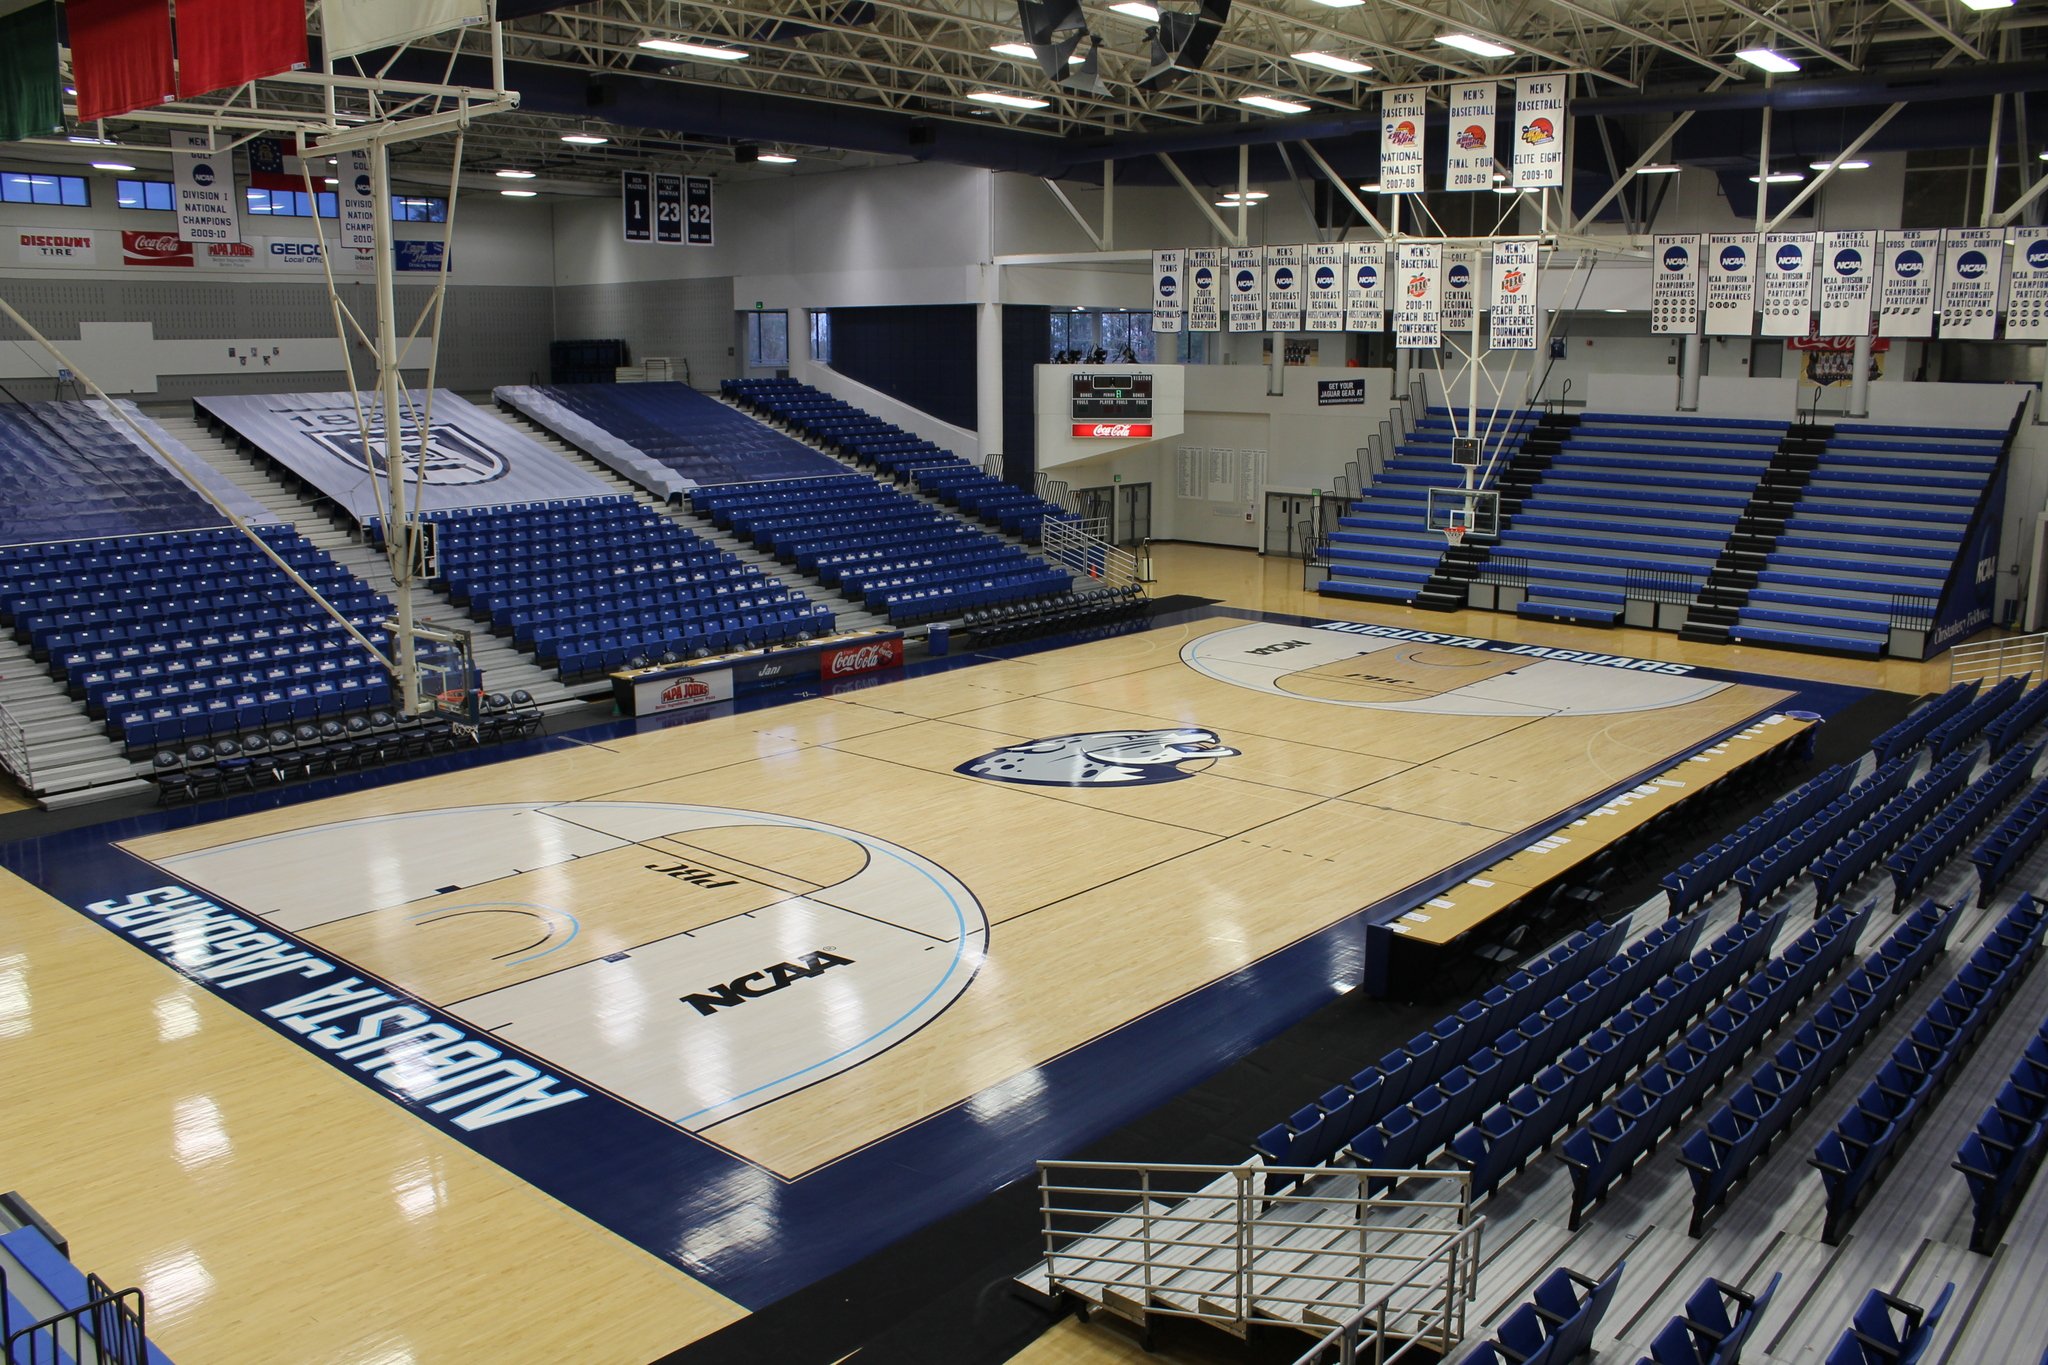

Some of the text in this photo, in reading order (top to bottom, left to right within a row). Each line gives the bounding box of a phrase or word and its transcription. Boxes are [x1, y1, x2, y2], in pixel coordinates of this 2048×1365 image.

[1530, 84, 1552, 94] MEN'S
[1394, 93, 1414, 103] MEN'S
[1463, 89, 1484, 101] MEN'S
[1517, 99, 1562, 111] BASKETBALL
[1382, 106, 1424, 118] BASKETBALL
[1451, 105, 1494, 117] BASKETBALL
[1381, 151, 1422, 162] NATIONAL
[1514, 152, 1561, 164] ELITE EIGHT
[353, 162, 369, 171] GOL
[1449, 157, 1493, 168] FINAL FOUR
[1382, 164, 1422, 176] FINALIST
[1521, 169, 1553, 180] 2009-10
[1386, 179, 1415, 189] 2007-08
[1454, 174, 1486, 185] 2008-09
[182, 190, 228, 200] DIVISION I
[185, 203, 227, 213] NATIONAL
[345, 200, 372, 208] DIVISIO
[634, 200, 641, 219] 1
[659, 202, 680, 221] 23
[689, 204, 710, 223] 32
[183, 216, 231, 226] CHAMPIONS
[191, 228, 226, 238] 2009-10
[1904, 231, 1921, 239] MEN'S
[1961, 231, 1990, 239] WOMEN'S
[2018, 229, 2039, 238] MEN'S
[20, 235, 91, 248] DISCOUNT
[135, 235, 179, 251] Coca-Cola
[1659, 237, 1676, 245] MEN'S
[1767, 235, 1814, 243] MEN'S BASKETBALL
[1505, 244, 1526, 253] MEN'S
[1829, 240, 1869, 248] BASKETBALL
[1911, 240, 1937, 248] COUNTRY
[1947, 240, 2001, 248] CROSS COUNTRY
[41, 248, 72, 256] TIRE
[208, 243, 228, 257] PAPA
[270, 243, 328, 255] GEICO
[1277, 248, 1293, 256] MEN'S
[1360, 246, 1376, 254] MEN'S
[1410, 247, 1430, 256] MEN'S
[1161, 254, 1176, 262] MEN'S
[1238, 250, 1253, 258] MEN'S
[1230, 260, 1261, 268] BASKETBALL
[1268, 258, 1300, 266] BASKETBALL
[1350, 256, 1383, 264] BASKETBALL
[1401, 259, 1438, 268] BASKETBALL
[1495, 255, 1534, 264] BASKETBALL
[1722, 257, 1744, 265] NCAA
[1836, 261, 1860, 269] NCAA
[1897, 263, 1922, 271] NCAA
[1959, 264, 1986, 272] NCAA
[2012, 271, 2028, 279] NCAA
[1842, 276, 1863, 284] DIVISION
[1922, 279, 1928, 287] II
[1952, 282, 1990, 290] DIVISION II
[1269, 292, 1300, 300] SOUTHEAST
[1310, 291, 1340, 299] SOUTHEAST
[1445, 292, 1472, 300] CENTRAL
[1827, 292, 1866, 300] PARTICIPANT
[1885, 288, 1931, 296] CHAMPIONSHIP
[1946, 291, 1994, 299] CHAMPIONSHIP
[1230, 293, 1260, 302] SOUTHEAST
[1500, 295, 1528, 304] 2010-11
[1886, 297, 1928, 305] PARTICIPANT
[1271, 302, 1297, 310] REGIONAL
[1312, 301, 1337, 309] REGIONAL
[1352, 300, 1378, 308] REGIONAL
[1405, 301, 1432, 310] 2010-11
[1444, 301, 1473, 309] REGIONAL
[1948, 300, 1991, 308] PARTICIPANT
[1492, 305, 1535, 315] PEACH BELT
[1398, 312, 1439, 322] PEACH BELT
[1492, 316, 1534, 326] CONFERENCE
[1235, 322, 1256, 330] 2010-11
[1272, 321, 1295, 329] 2009-10
[1353, 320, 1377, 328] 2007-08
[1449, 319, 1466, 327] 2005
[1398, 324, 1438, 333] CONFERENCE
[1492, 327, 1534, 337] TOURNAMENT
[1398, 336, 1438, 345] CHAMPIONS
[1492, 338, 1534, 347] CHAMPIONS
[1320, 390, 1340, 398] JAGUAR
[1341, 389, 1356, 397] GEAR
[1093, 424, 1131, 437] Coca-Cola
[1975, 556, 1996, 585] NCAA
[1312, 621, 1696, 675] AUGUSTA JAGUARS
[831, 645, 879, 674] Coca-Cola
[758, 664, 781, 677] Jani
[663, 686, 683, 701] PAPA
[644, 861, 740, 889] PBC
[679, 950, 856, 1016] NCAA
[85, 885, 589, 1132] AUGUSTA JAGUARS
